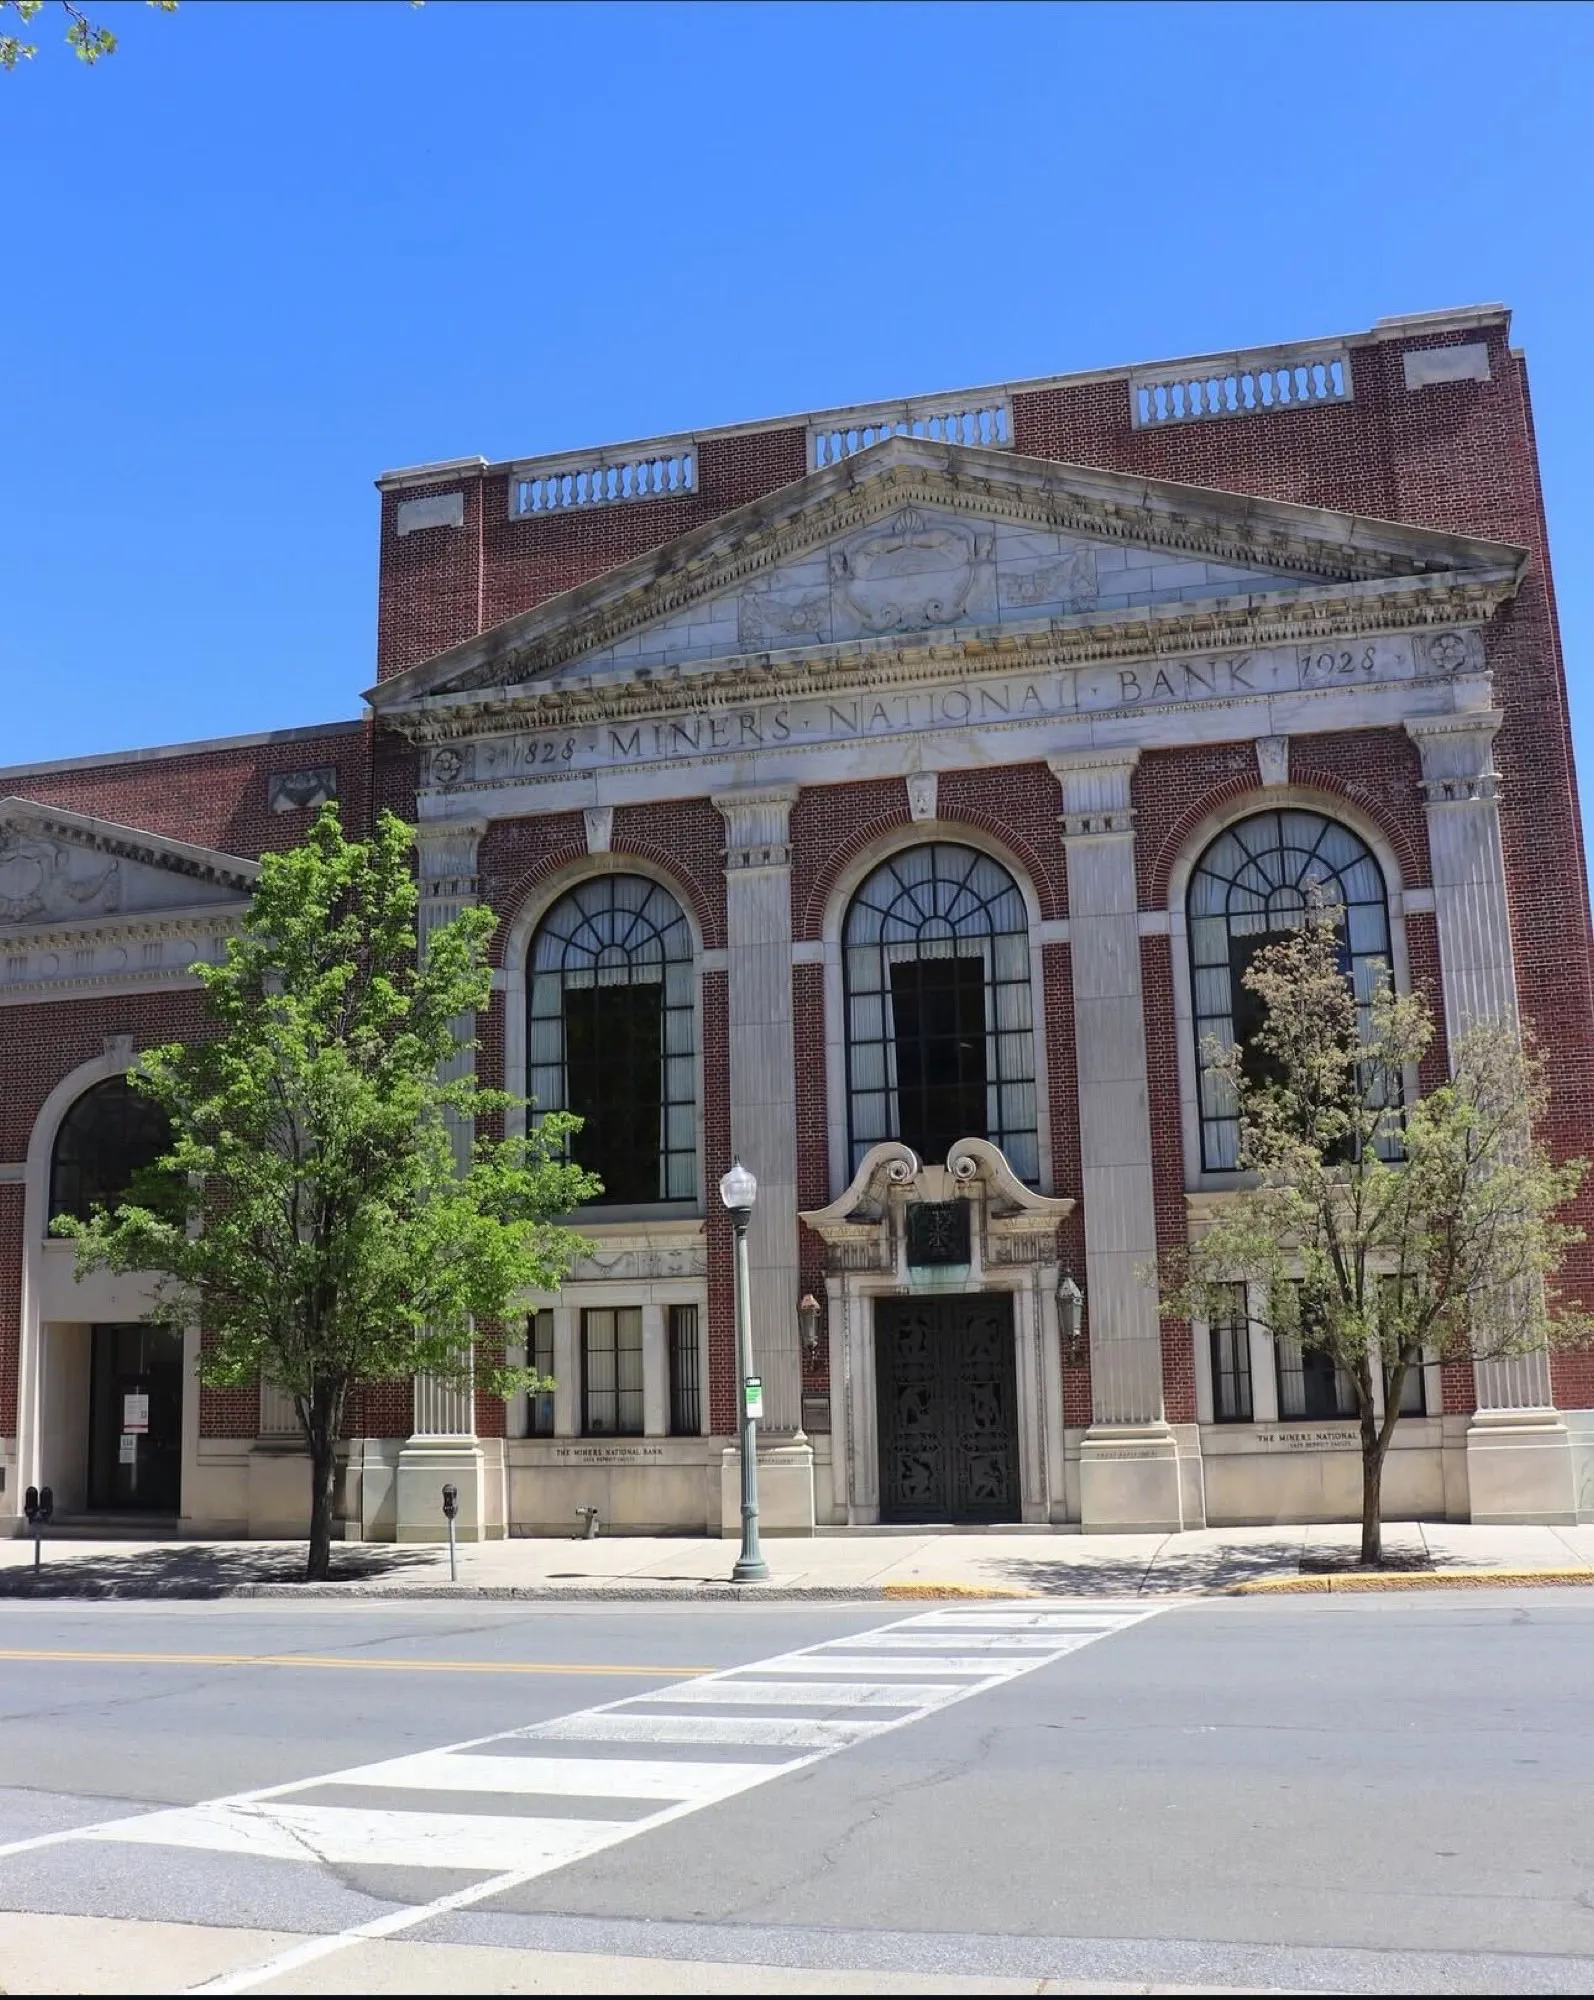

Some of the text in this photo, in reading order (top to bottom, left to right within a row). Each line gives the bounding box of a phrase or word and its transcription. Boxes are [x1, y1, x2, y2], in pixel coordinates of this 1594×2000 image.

[512, 647, 1376, 767] 1828 MINERS NATIONAL BANK 1928
[1316, 1431, 1358, 1440] NATIONAL
[556, 1448, 570, 1456] THE
